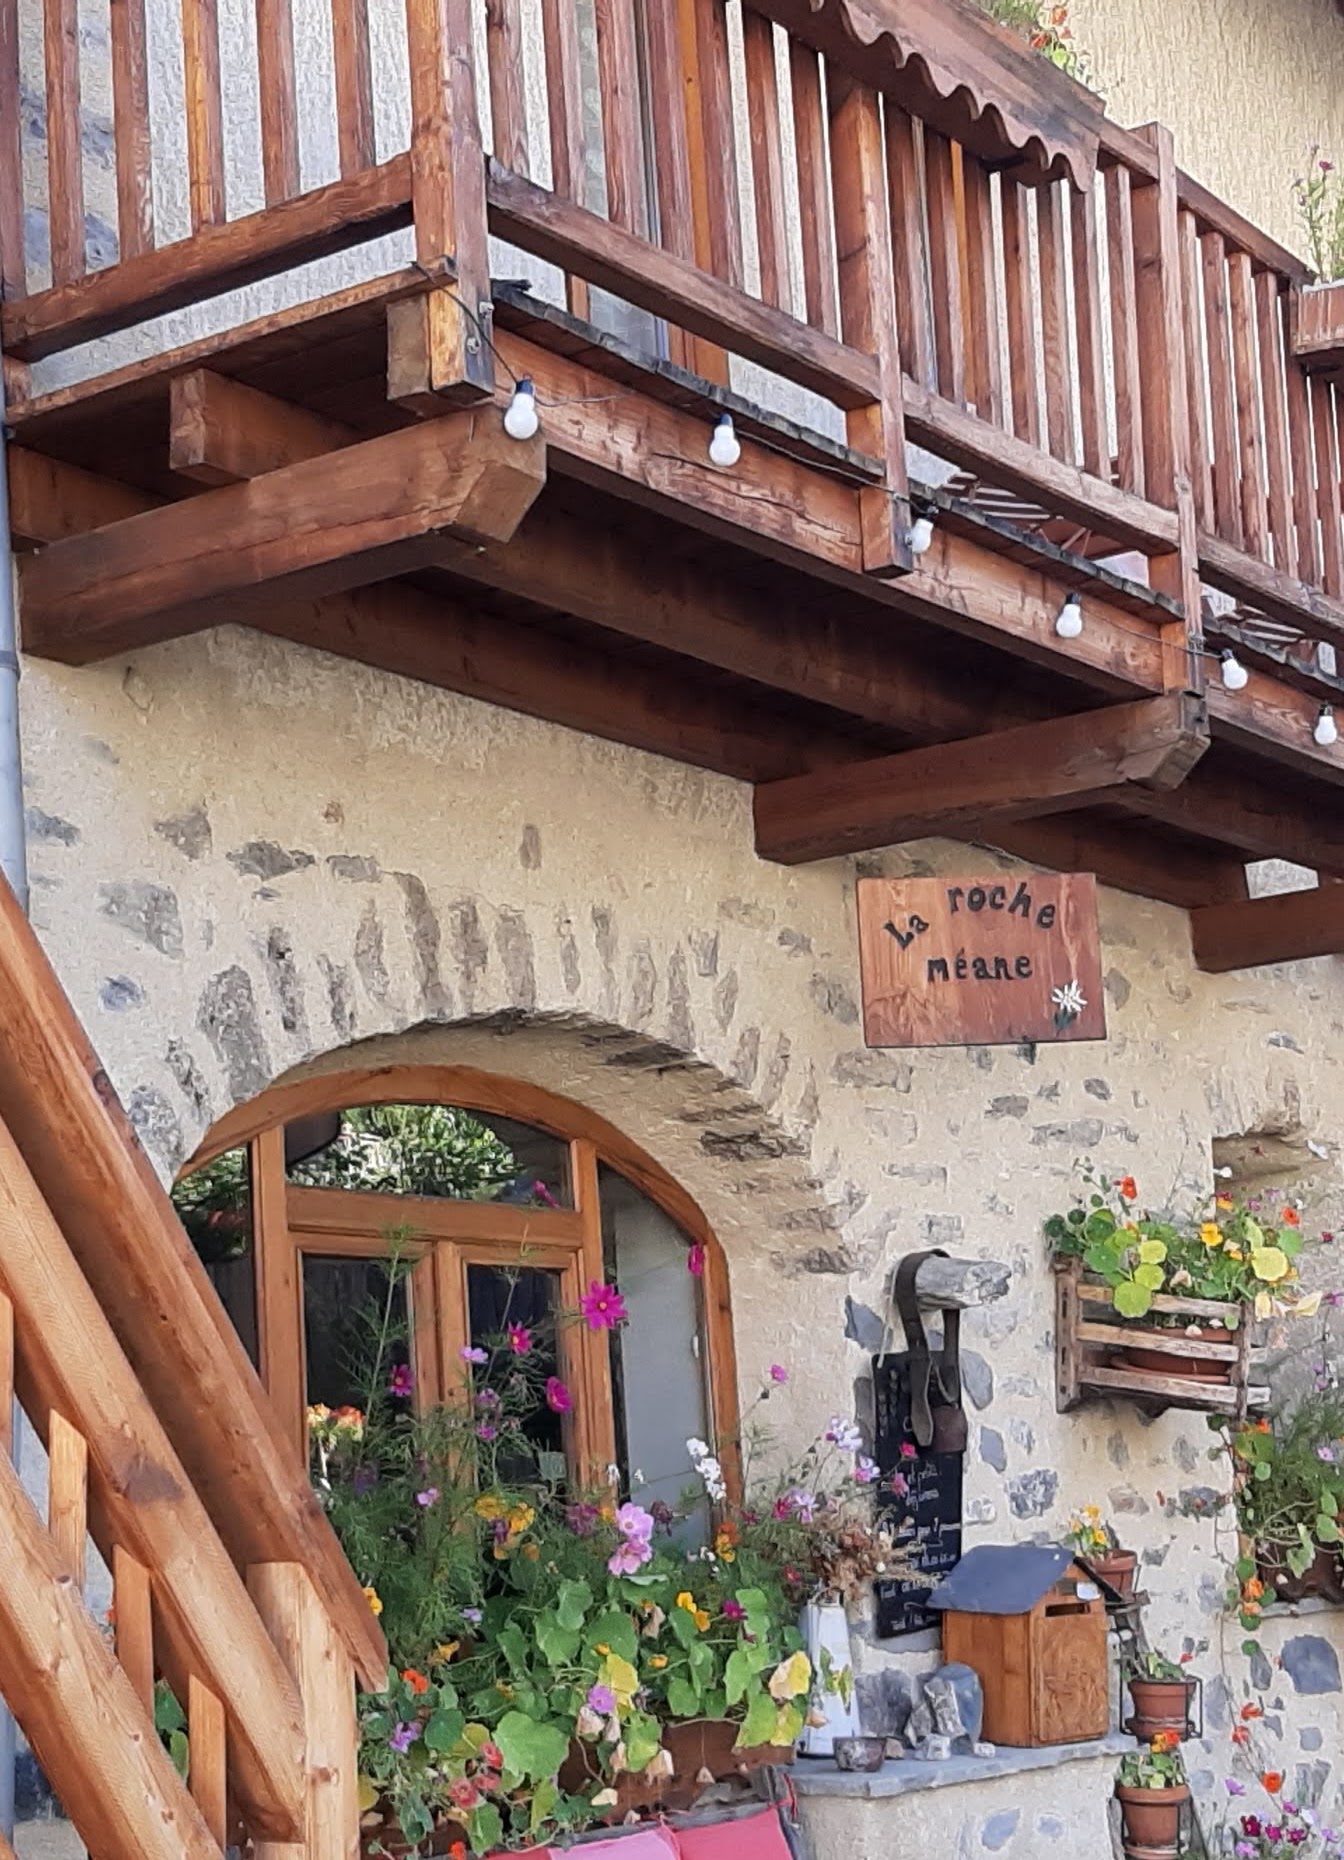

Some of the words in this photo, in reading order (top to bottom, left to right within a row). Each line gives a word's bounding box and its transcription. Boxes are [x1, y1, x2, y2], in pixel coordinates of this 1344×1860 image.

[883, 913, 930, 951] La
[946, 882, 1056, 929] roche
[926, 947, 1033, 983] méane
